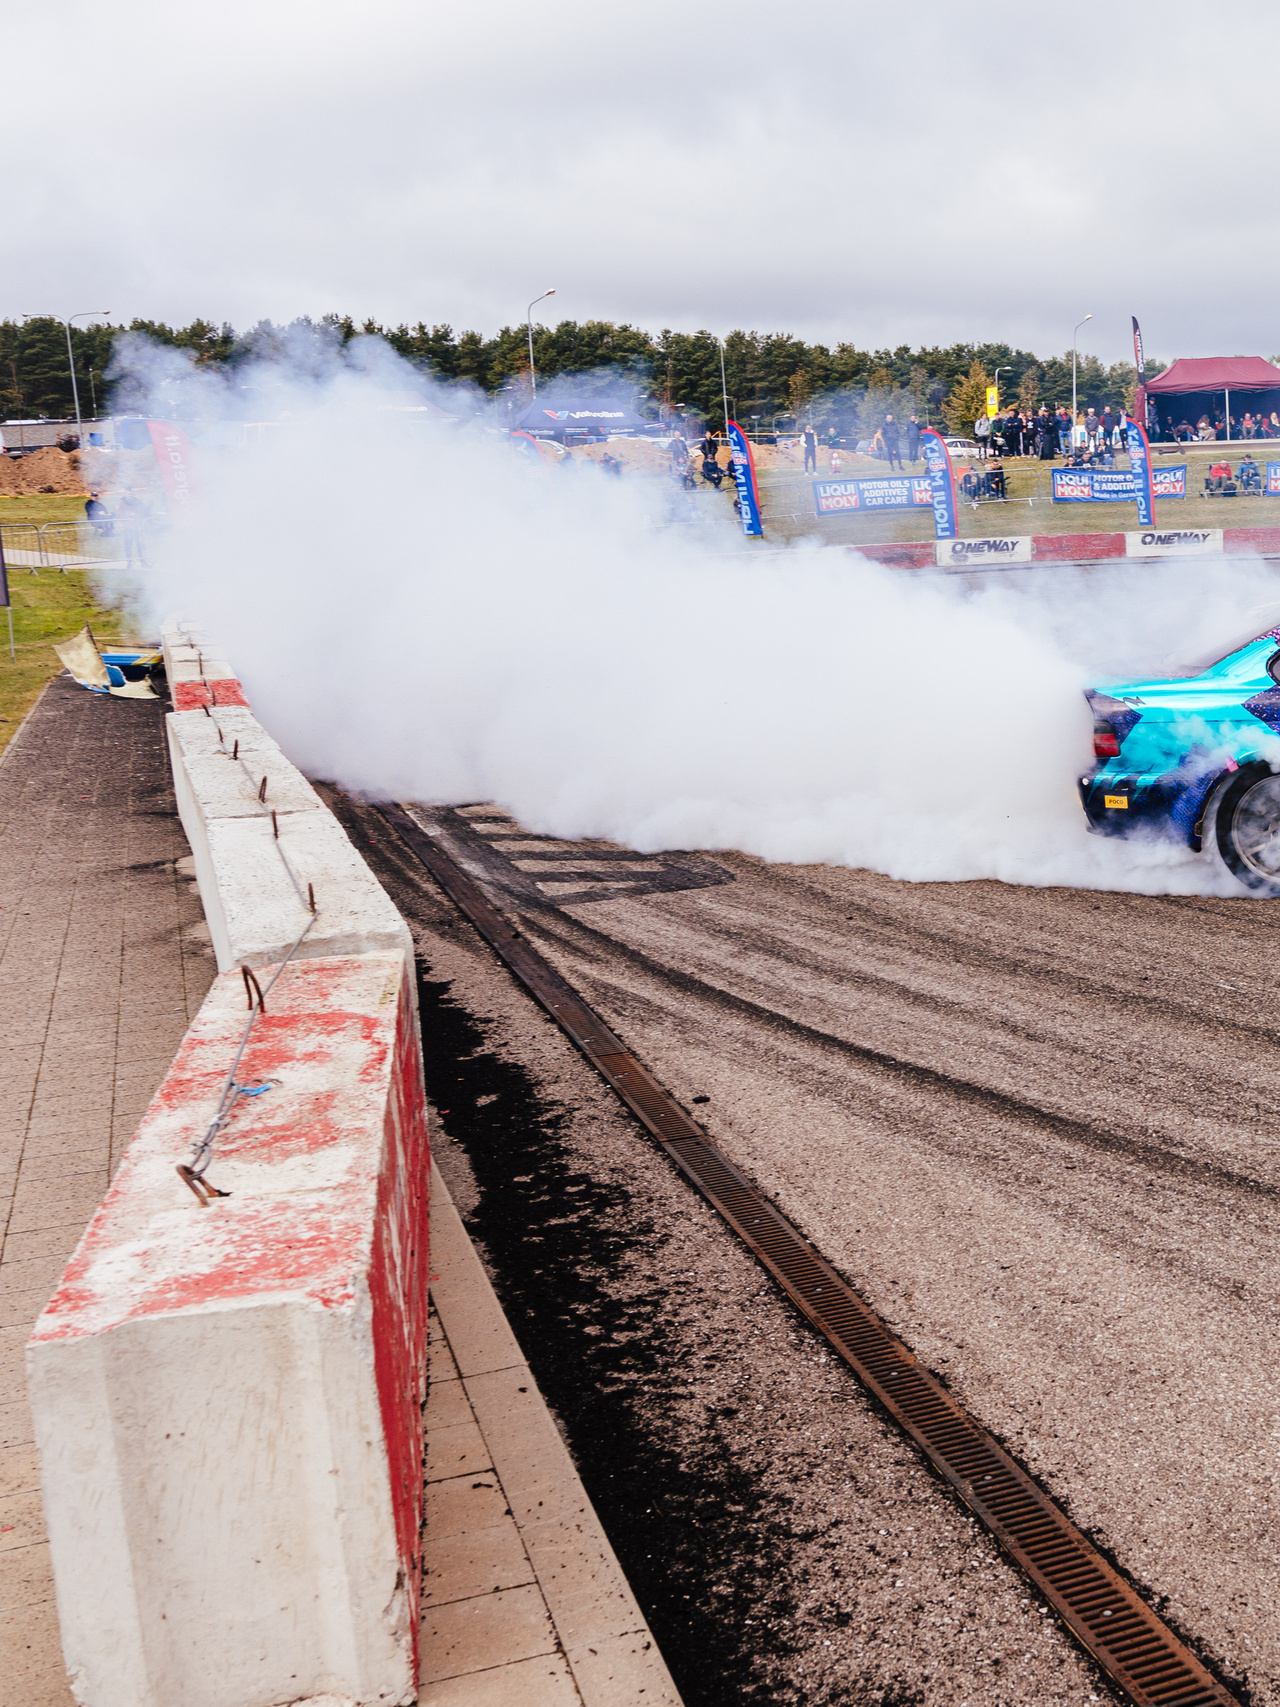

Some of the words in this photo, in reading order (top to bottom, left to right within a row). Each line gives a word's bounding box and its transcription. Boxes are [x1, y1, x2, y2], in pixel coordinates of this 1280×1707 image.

[569, 410, 625, 419] Valvoline
[859, 481, 888, 490] MOTOR
[890, 480, 910, 489] OILS
[1056, 474, 1089, 485] LIQUI
[820, 484, 855, 497] LIQUI
[1057, 485, 1091, 496] MOLY
[1101, 482, 1135, 491] ADDITIV
[863, 487, 908, 498] ADDITIVES
[821, 495, 857, 510] MOLY
[865, 497, 883, 506] CAR
[885, 496, 908, 505] CARE
